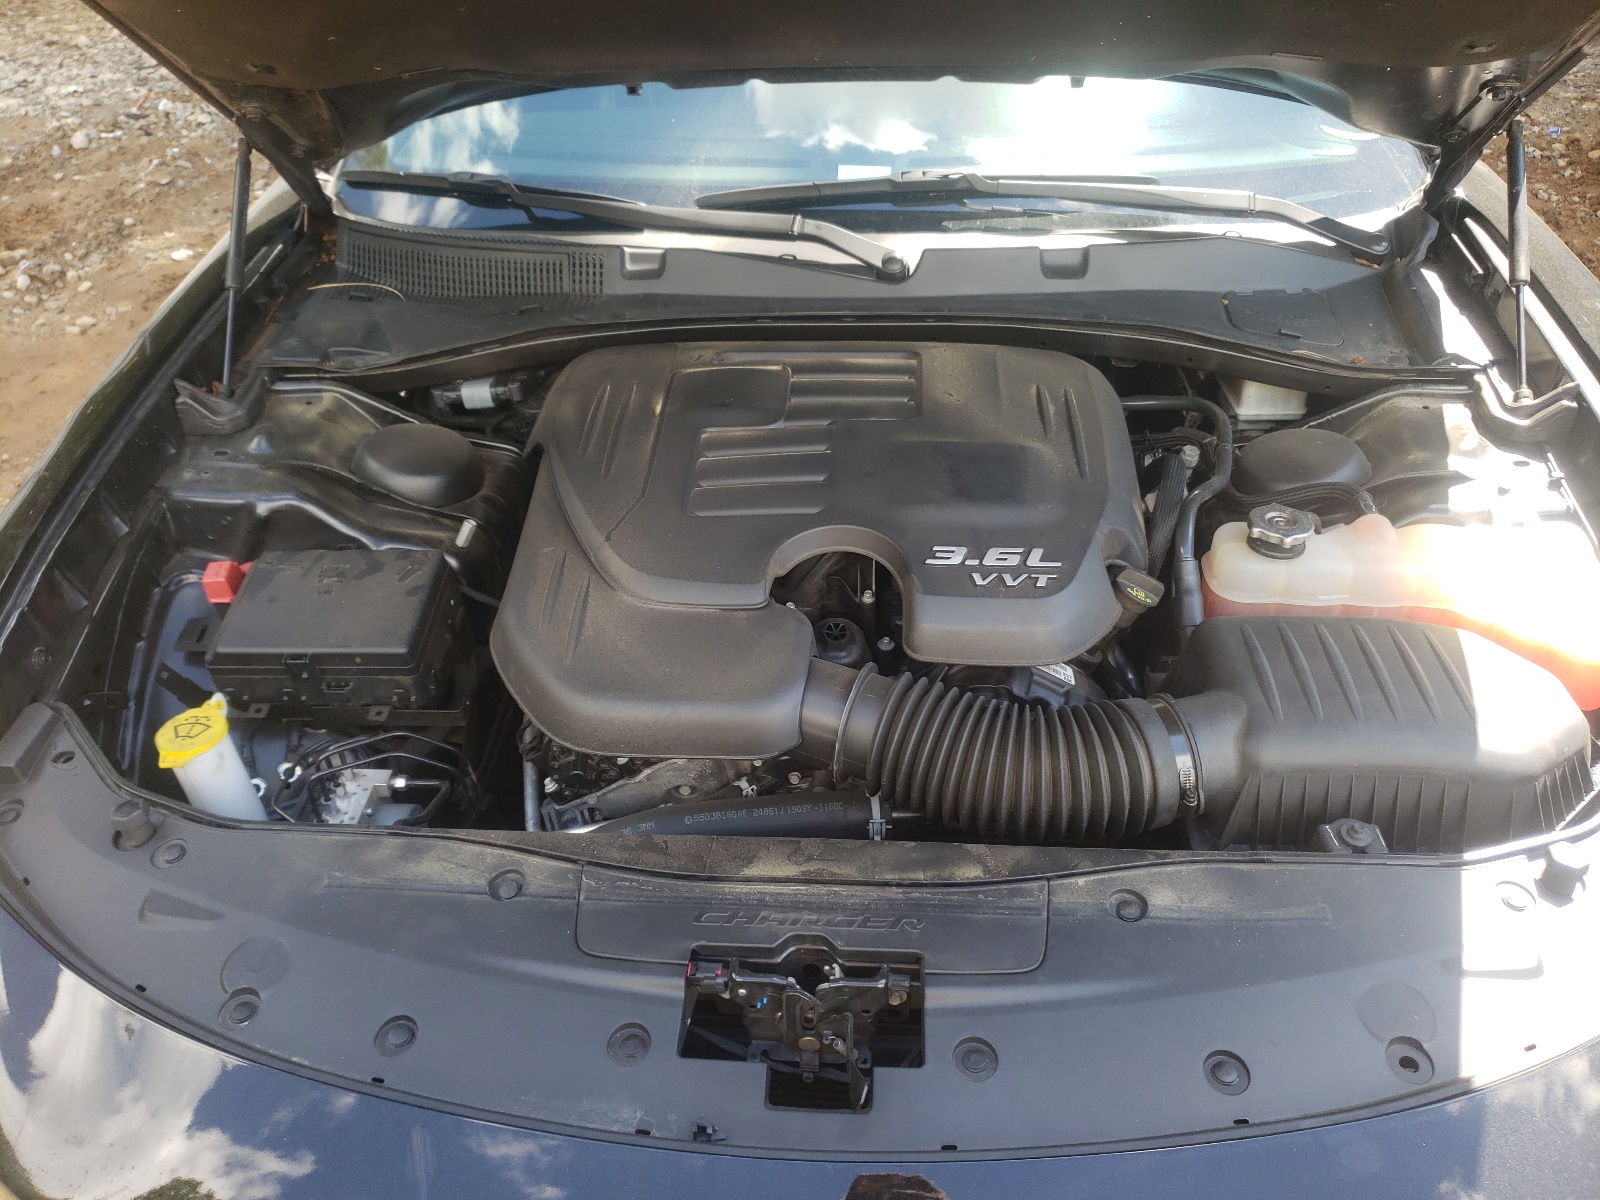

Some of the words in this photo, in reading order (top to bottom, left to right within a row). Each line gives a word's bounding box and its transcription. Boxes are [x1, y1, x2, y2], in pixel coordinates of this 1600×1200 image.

[924, 545, 1062, 567] 3.6L
[970, 572, 1058, 587] VVT
[692, 911, 926, 932] CHARGER
